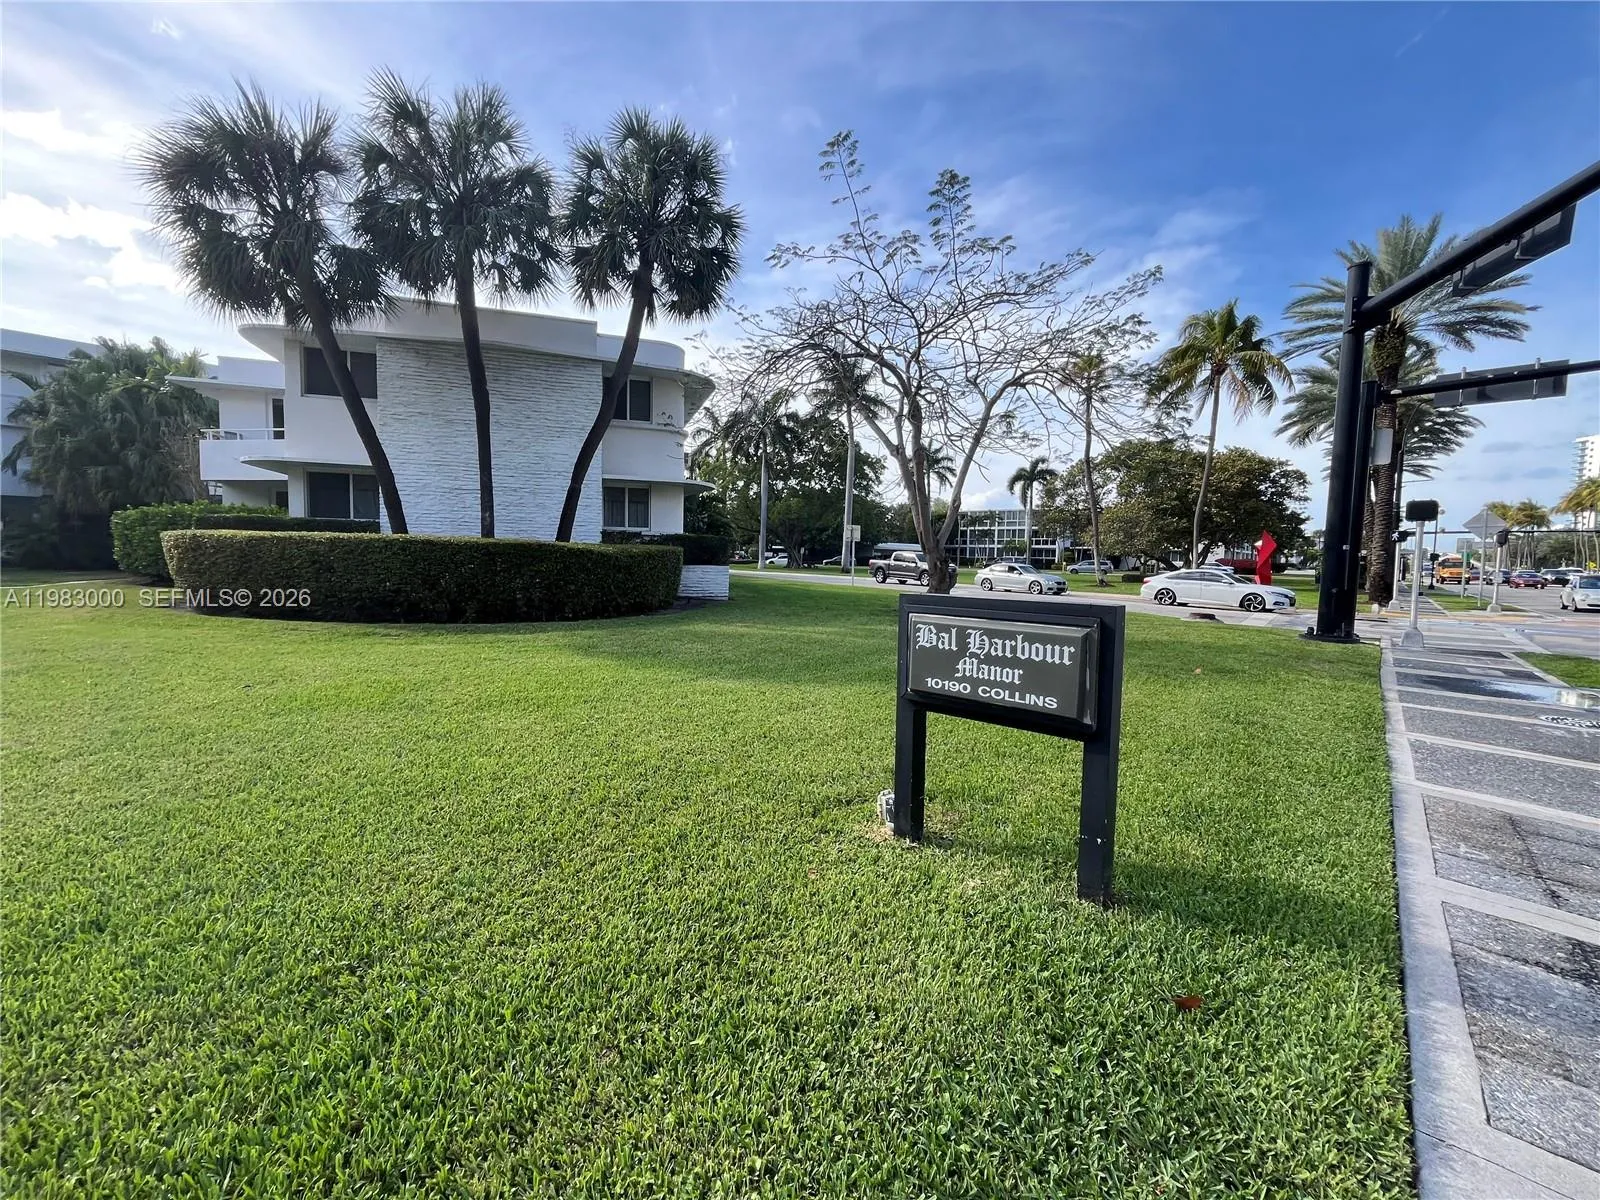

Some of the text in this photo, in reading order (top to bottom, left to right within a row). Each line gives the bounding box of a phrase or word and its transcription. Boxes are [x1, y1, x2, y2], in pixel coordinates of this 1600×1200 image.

[915, 624, 1076, 666] Bal Harbour
[954, 656, 1024, 685] Manor
[925, 677, 1058, 709] 10190 COLLINS
